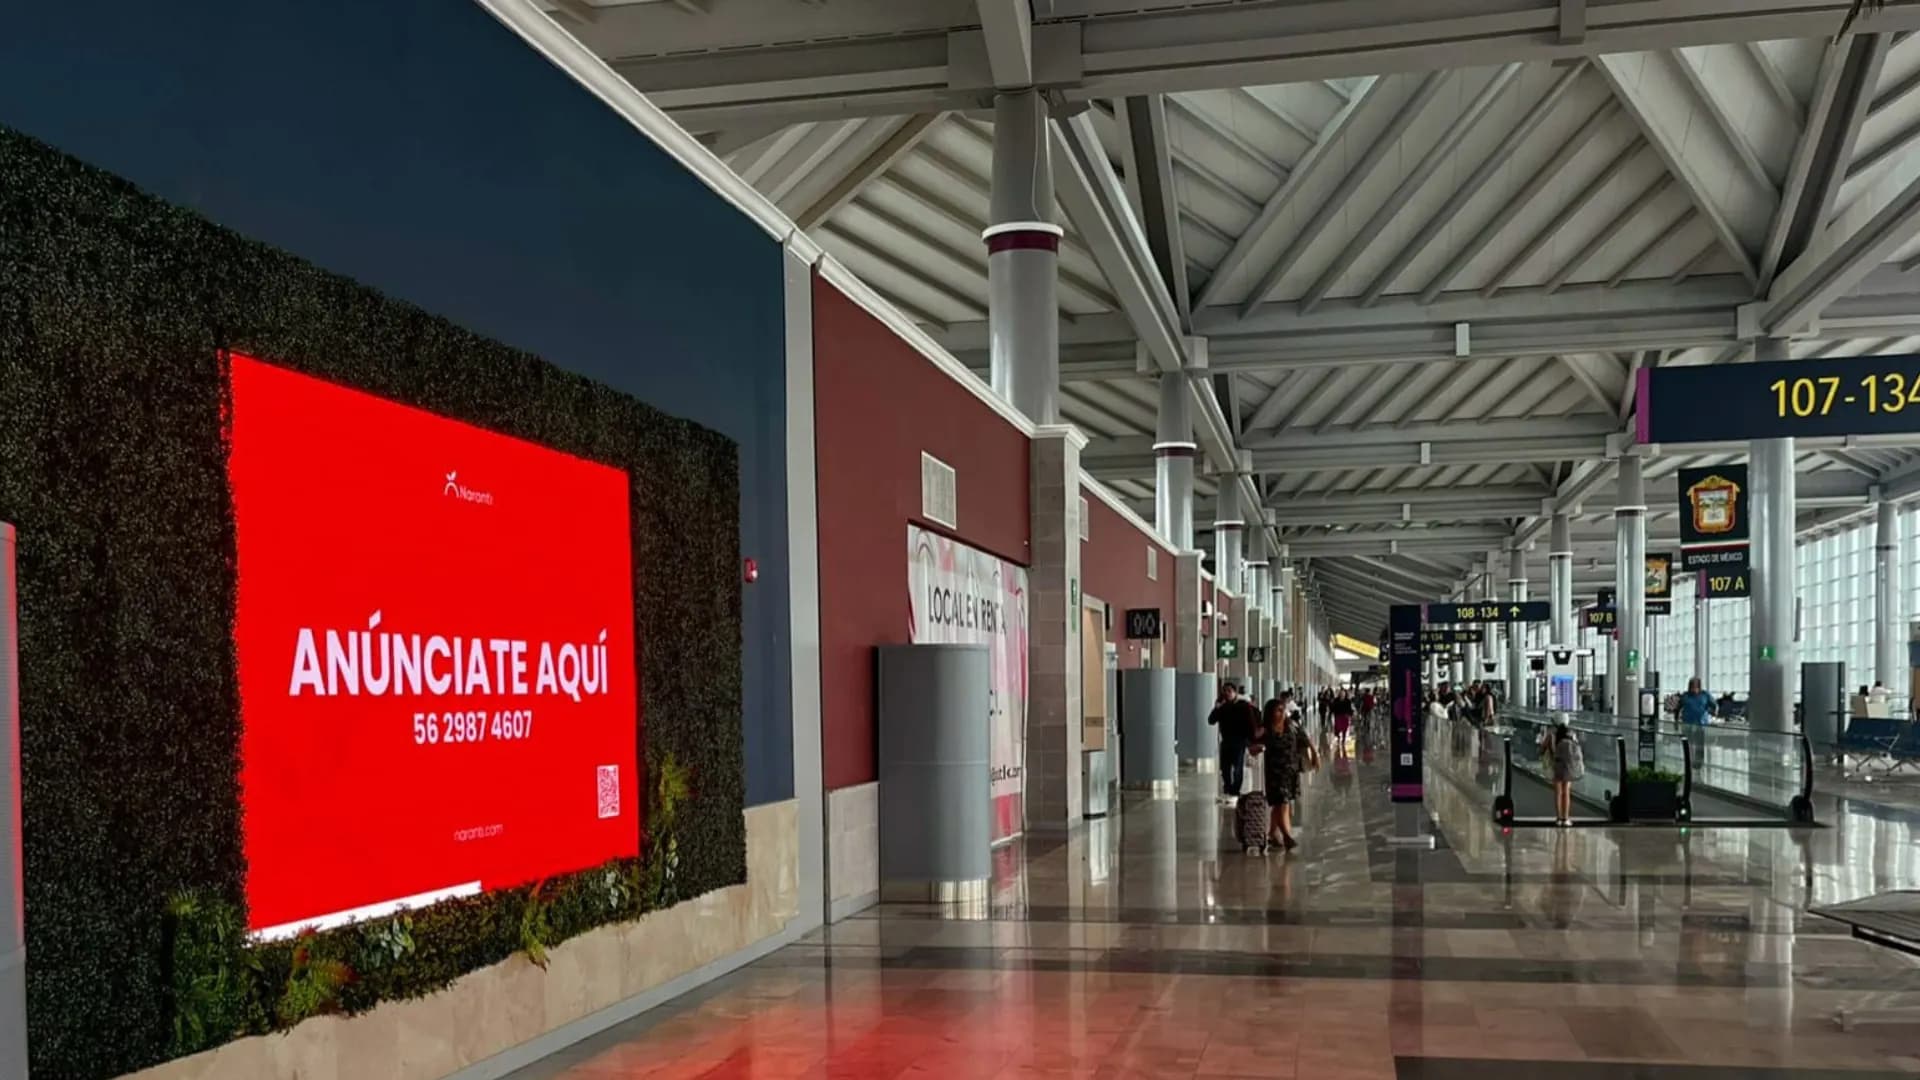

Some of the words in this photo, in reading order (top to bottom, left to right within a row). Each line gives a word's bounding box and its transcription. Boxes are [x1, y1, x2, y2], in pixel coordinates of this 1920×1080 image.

[1709, 576, 1732, 592] 107
[1734, 575, 1745, 591] A
[928, 584, 965, 628] LOCAL
[967, 593, 978, 631] EN
[1589, 611, 1604, 624] 107
[289, 609, 528, 696] ANÚNCIATE
[536, 628, 607, 702] AQUÍ
[413, 712, 439, 744] 56
[443, 711, 487, 743] 2987
[491, 710, 533, 740] 4607
